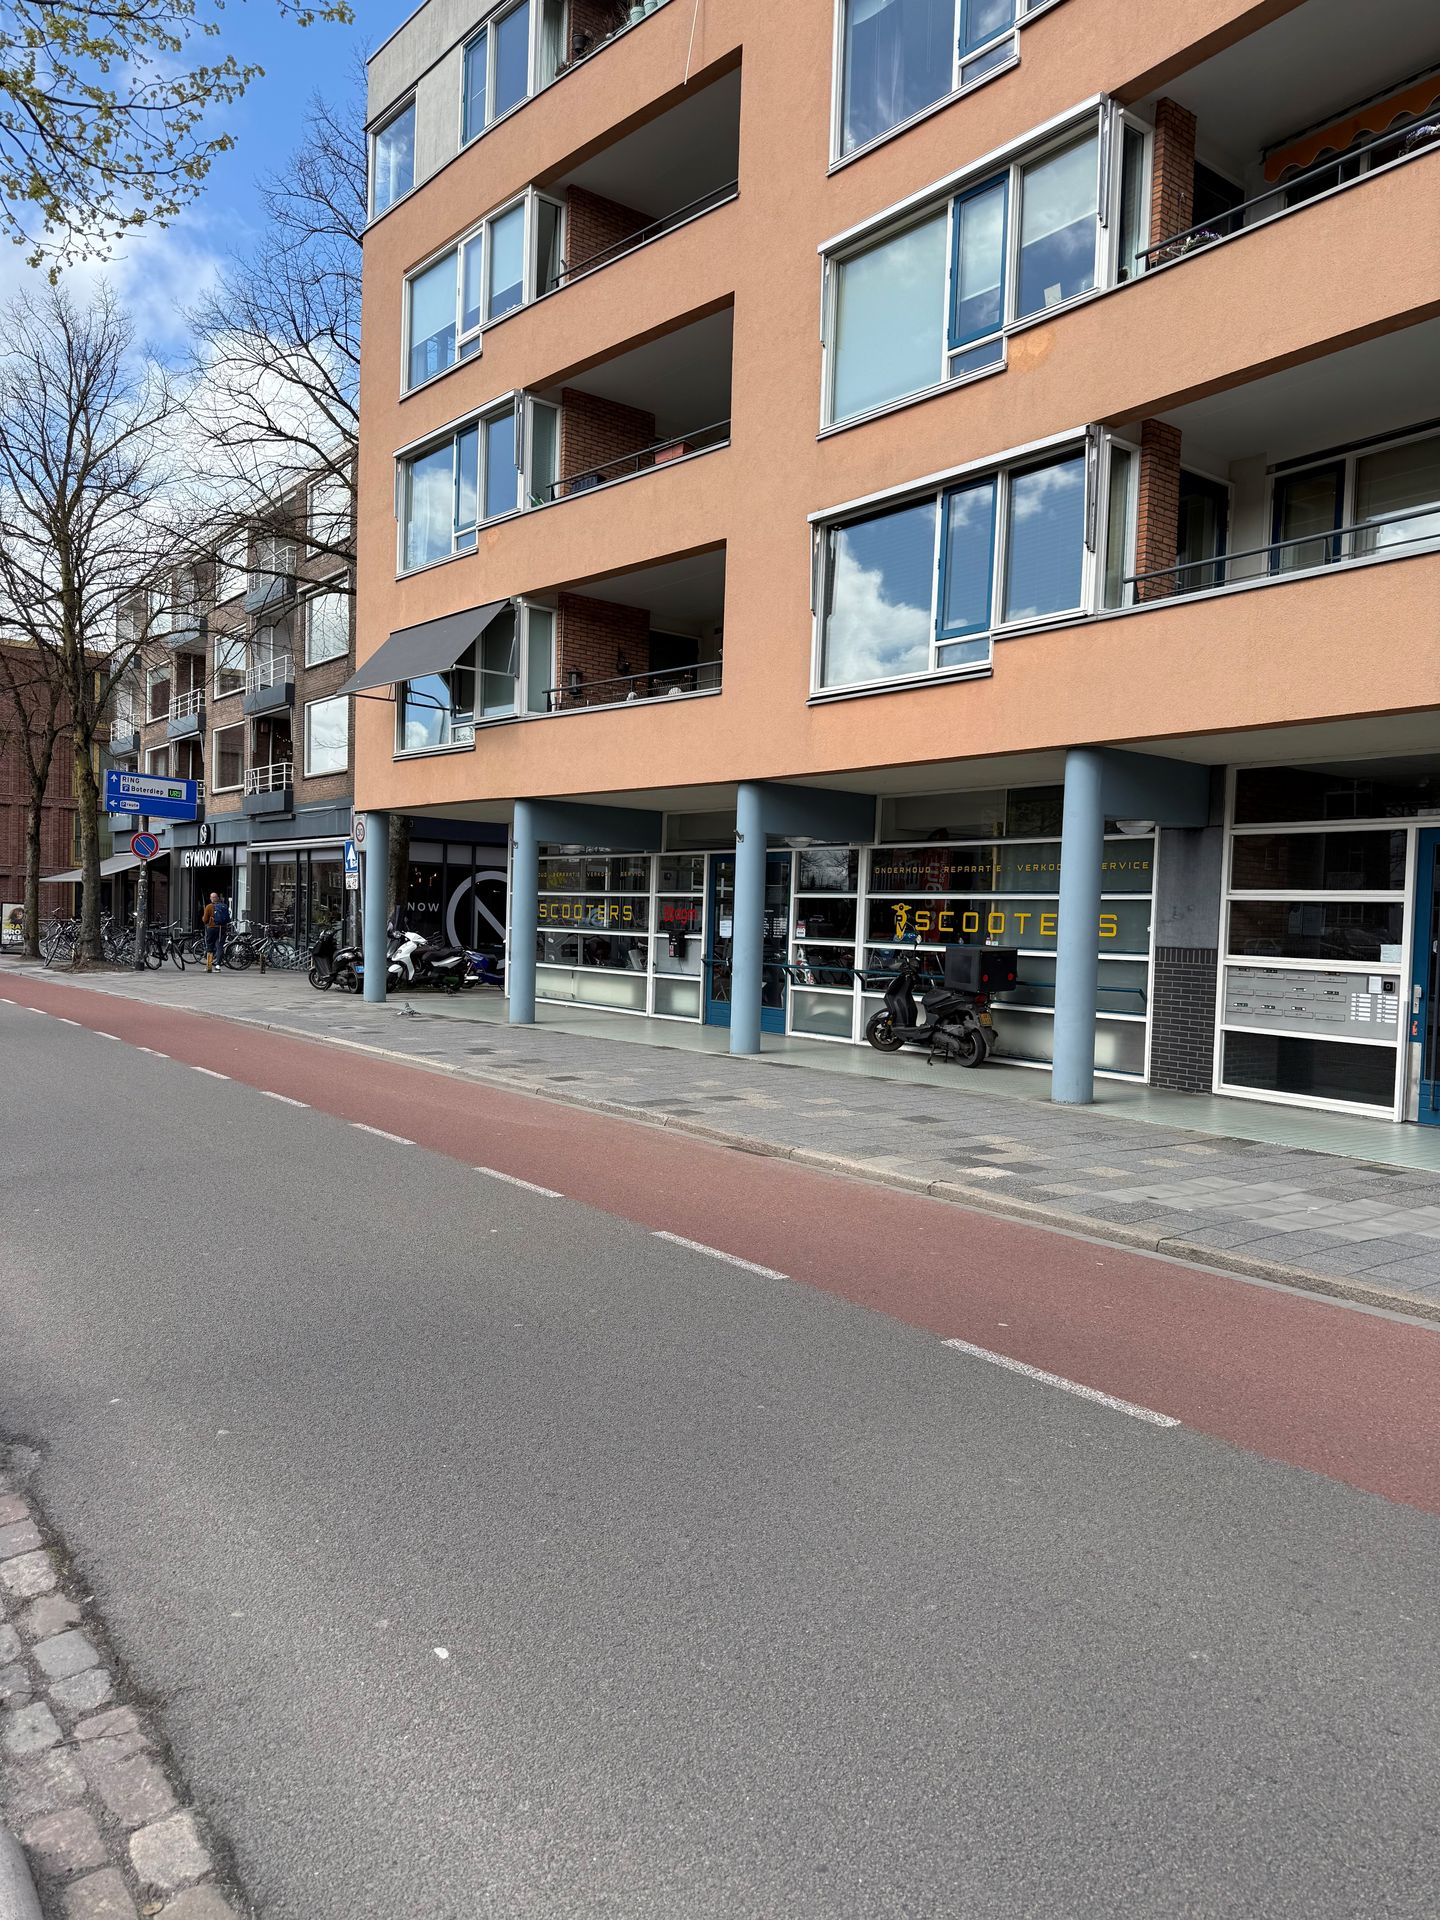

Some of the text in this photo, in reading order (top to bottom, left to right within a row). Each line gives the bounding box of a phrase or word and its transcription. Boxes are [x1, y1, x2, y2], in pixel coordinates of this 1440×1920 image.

[122, 776, 140, 784] RING
[131, 786, 164, 796] Boterdiep
[185, 850, 218, 868] GYMNOW
[874, 866, 931, 874] ONDERHOUD
[1017, 863, 1061, 872] VERKOO
[1101, 861, 1150, 870] ERVICE
[407, 902, 440, 912] NOW
[539, 904, 632, 921] SCOOTERS
[915, 911, 1118, 937] SCOOTES
